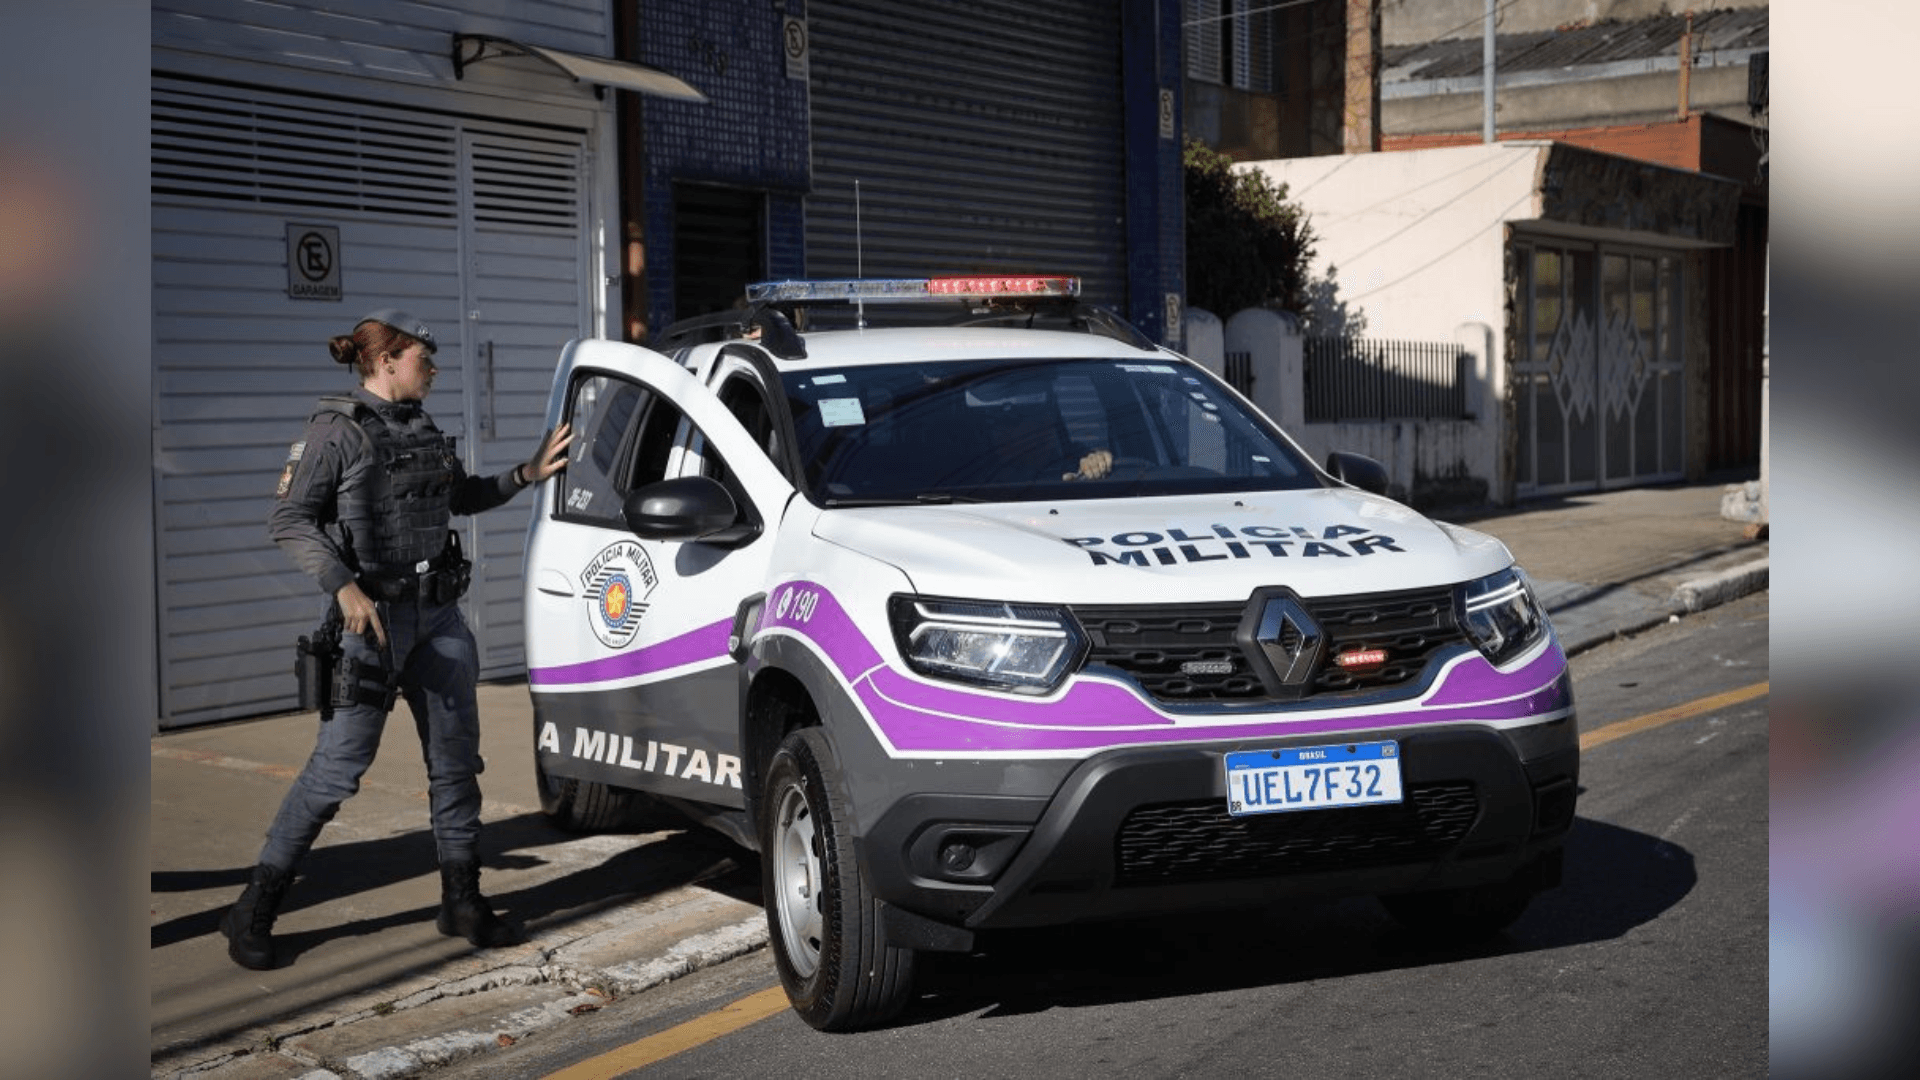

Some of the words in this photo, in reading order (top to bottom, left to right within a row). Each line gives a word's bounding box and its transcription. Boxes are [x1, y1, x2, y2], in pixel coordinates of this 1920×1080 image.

[293, 284, 339, 297] GARAGEM
[626, 545, 654, 589] MILITAR
[1088, 534, 1406, 567] MILITAR
[789, 589, 819, 623] 190
[572, 727, 743, 790] MILITAR
[1299, 750, 1328, 760] BRASIL
[1243, 764, 1383, 806] UEL7F32
